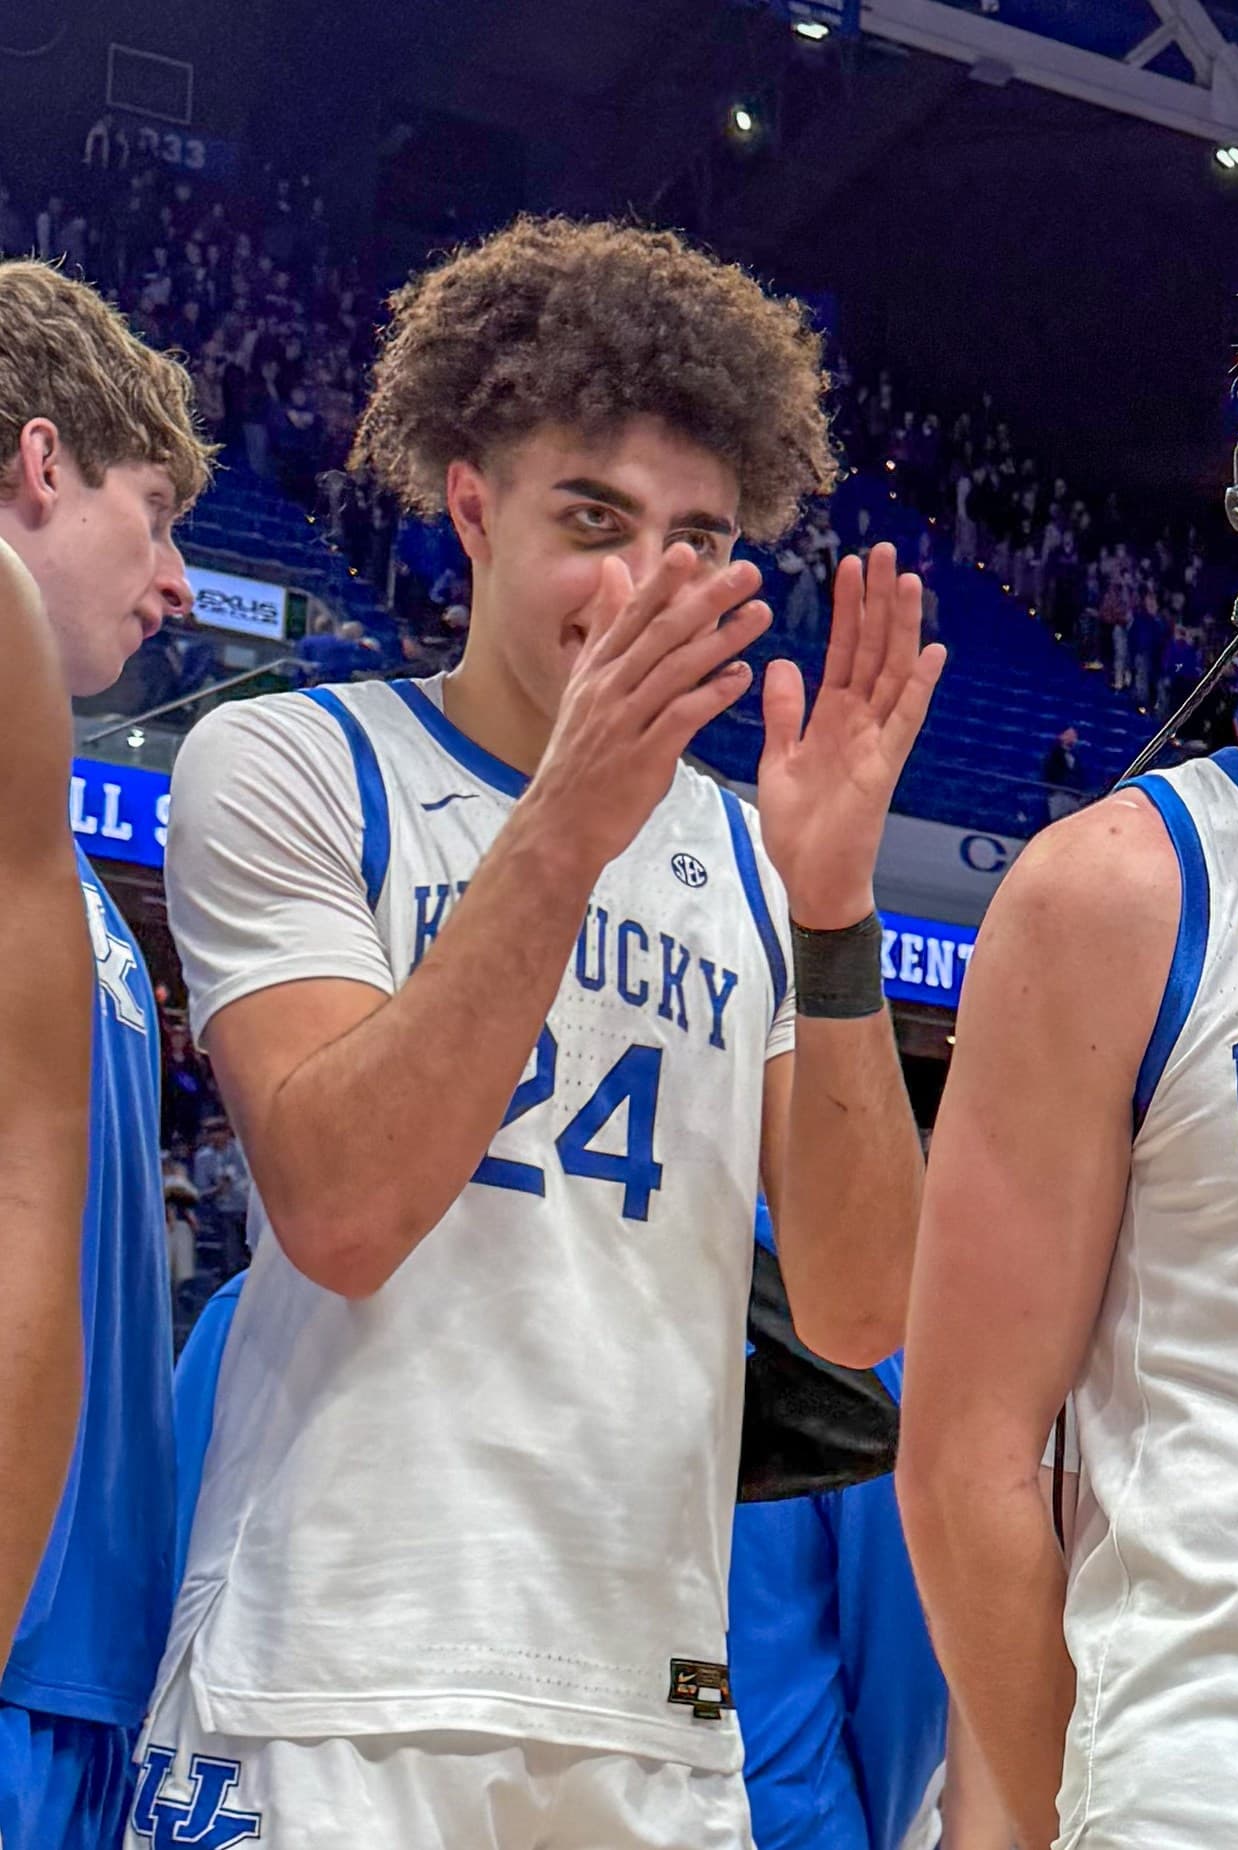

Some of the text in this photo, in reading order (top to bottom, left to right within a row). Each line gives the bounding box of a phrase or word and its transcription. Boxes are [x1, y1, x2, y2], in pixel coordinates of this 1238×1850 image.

[196, 588, 278, 618] EXUS
[671, 853, 708, 887] SEC
[410, 881, 739, 1050] KUCKY
